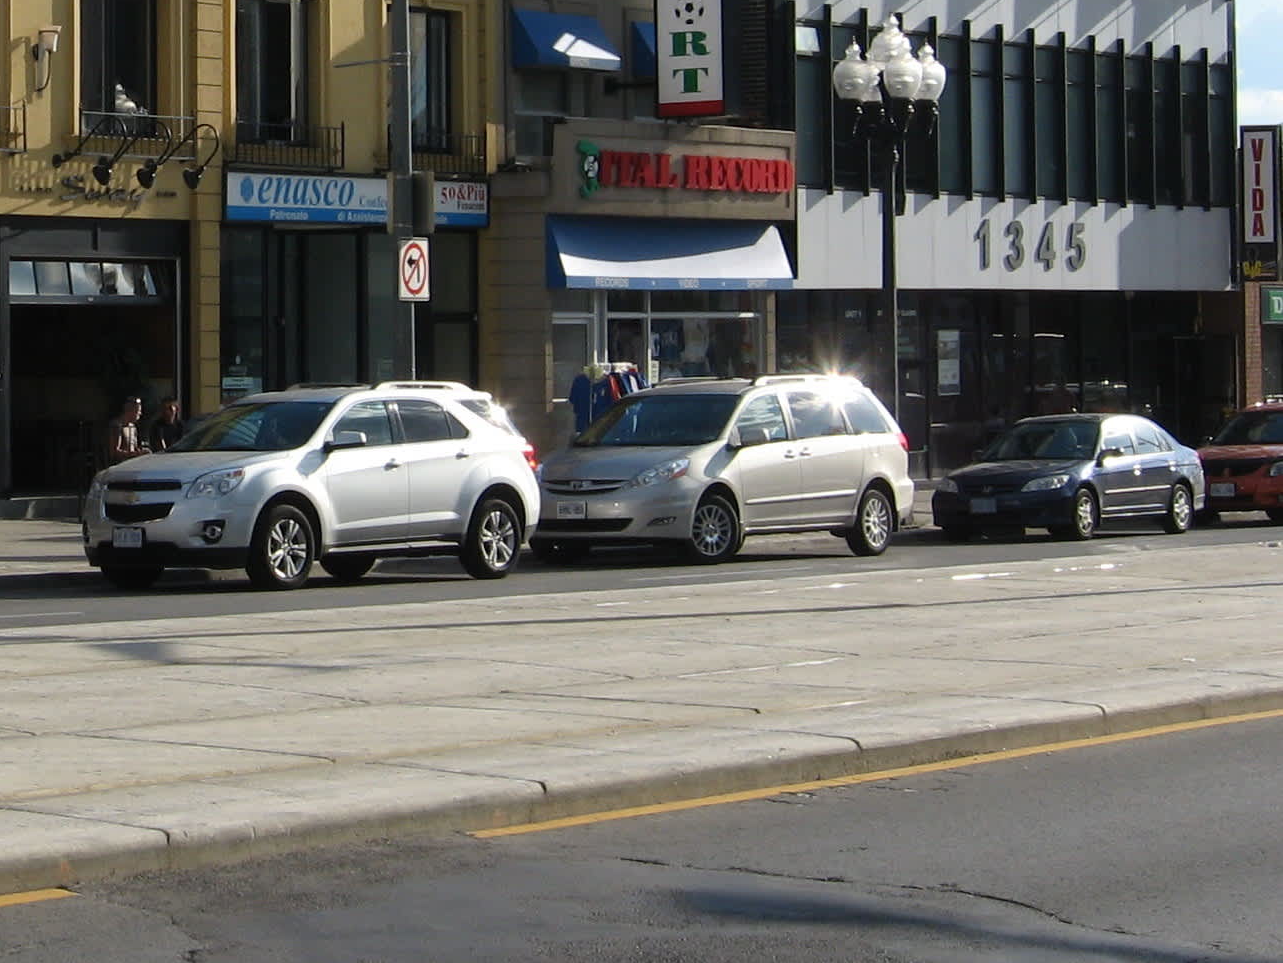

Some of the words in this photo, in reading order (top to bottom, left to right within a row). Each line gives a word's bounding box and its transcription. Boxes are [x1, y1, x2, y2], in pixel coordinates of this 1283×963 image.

[257, 175, 355, 207] enasco
[598, 150, 678, 188] ITAL
[683, 154, 795, 193] RECORD
[1251, 138, 1264, 236] VIDA
[973, 219, 1086, 272] 1345
